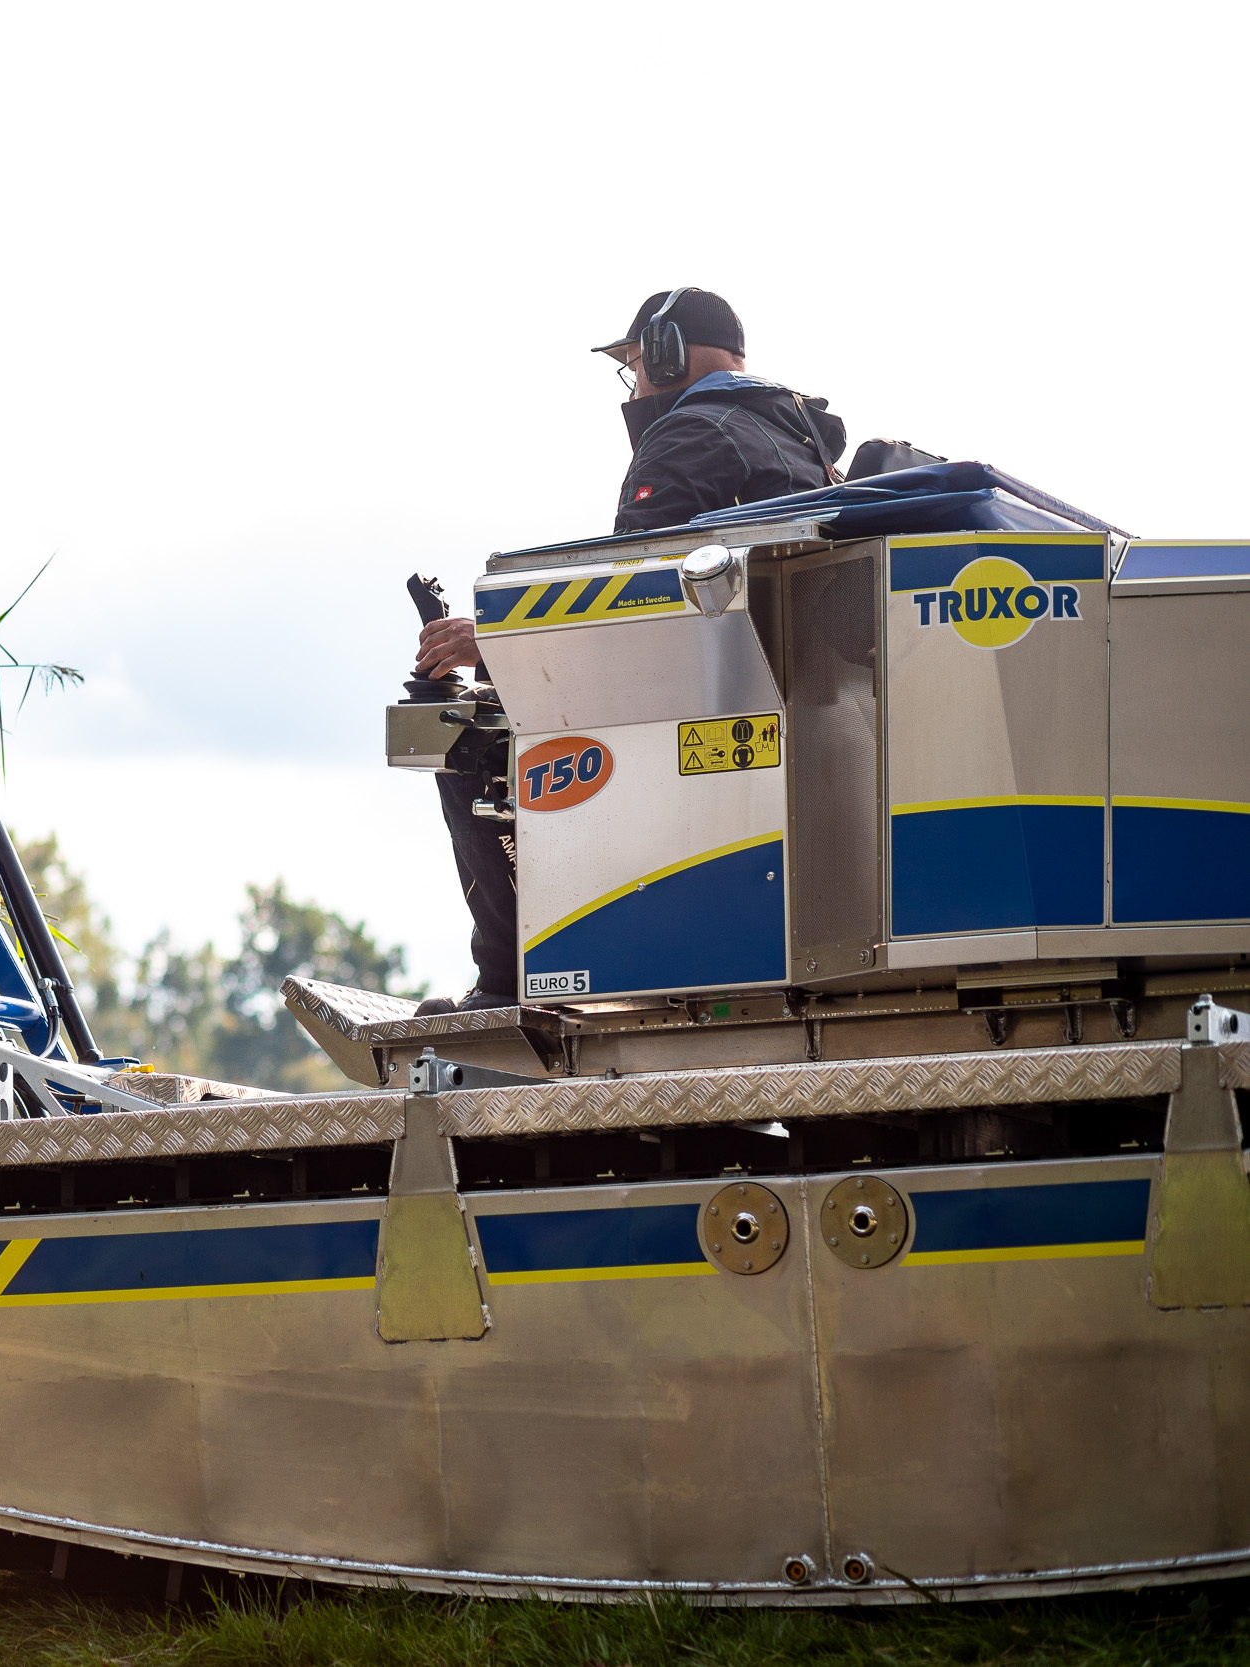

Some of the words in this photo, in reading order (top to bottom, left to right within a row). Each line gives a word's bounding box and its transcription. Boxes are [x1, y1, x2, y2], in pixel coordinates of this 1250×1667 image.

[617, 599, 637, 607] Made
[637, 597, 644, 605] in
[645, 595, 671, 604] Sweden
[913, 585, 1080, 626] TRUXOR
[524, 746, 604, 802] T50
[530, 976, 569, 990] EURO
[572, 972, 587, 992] 5
